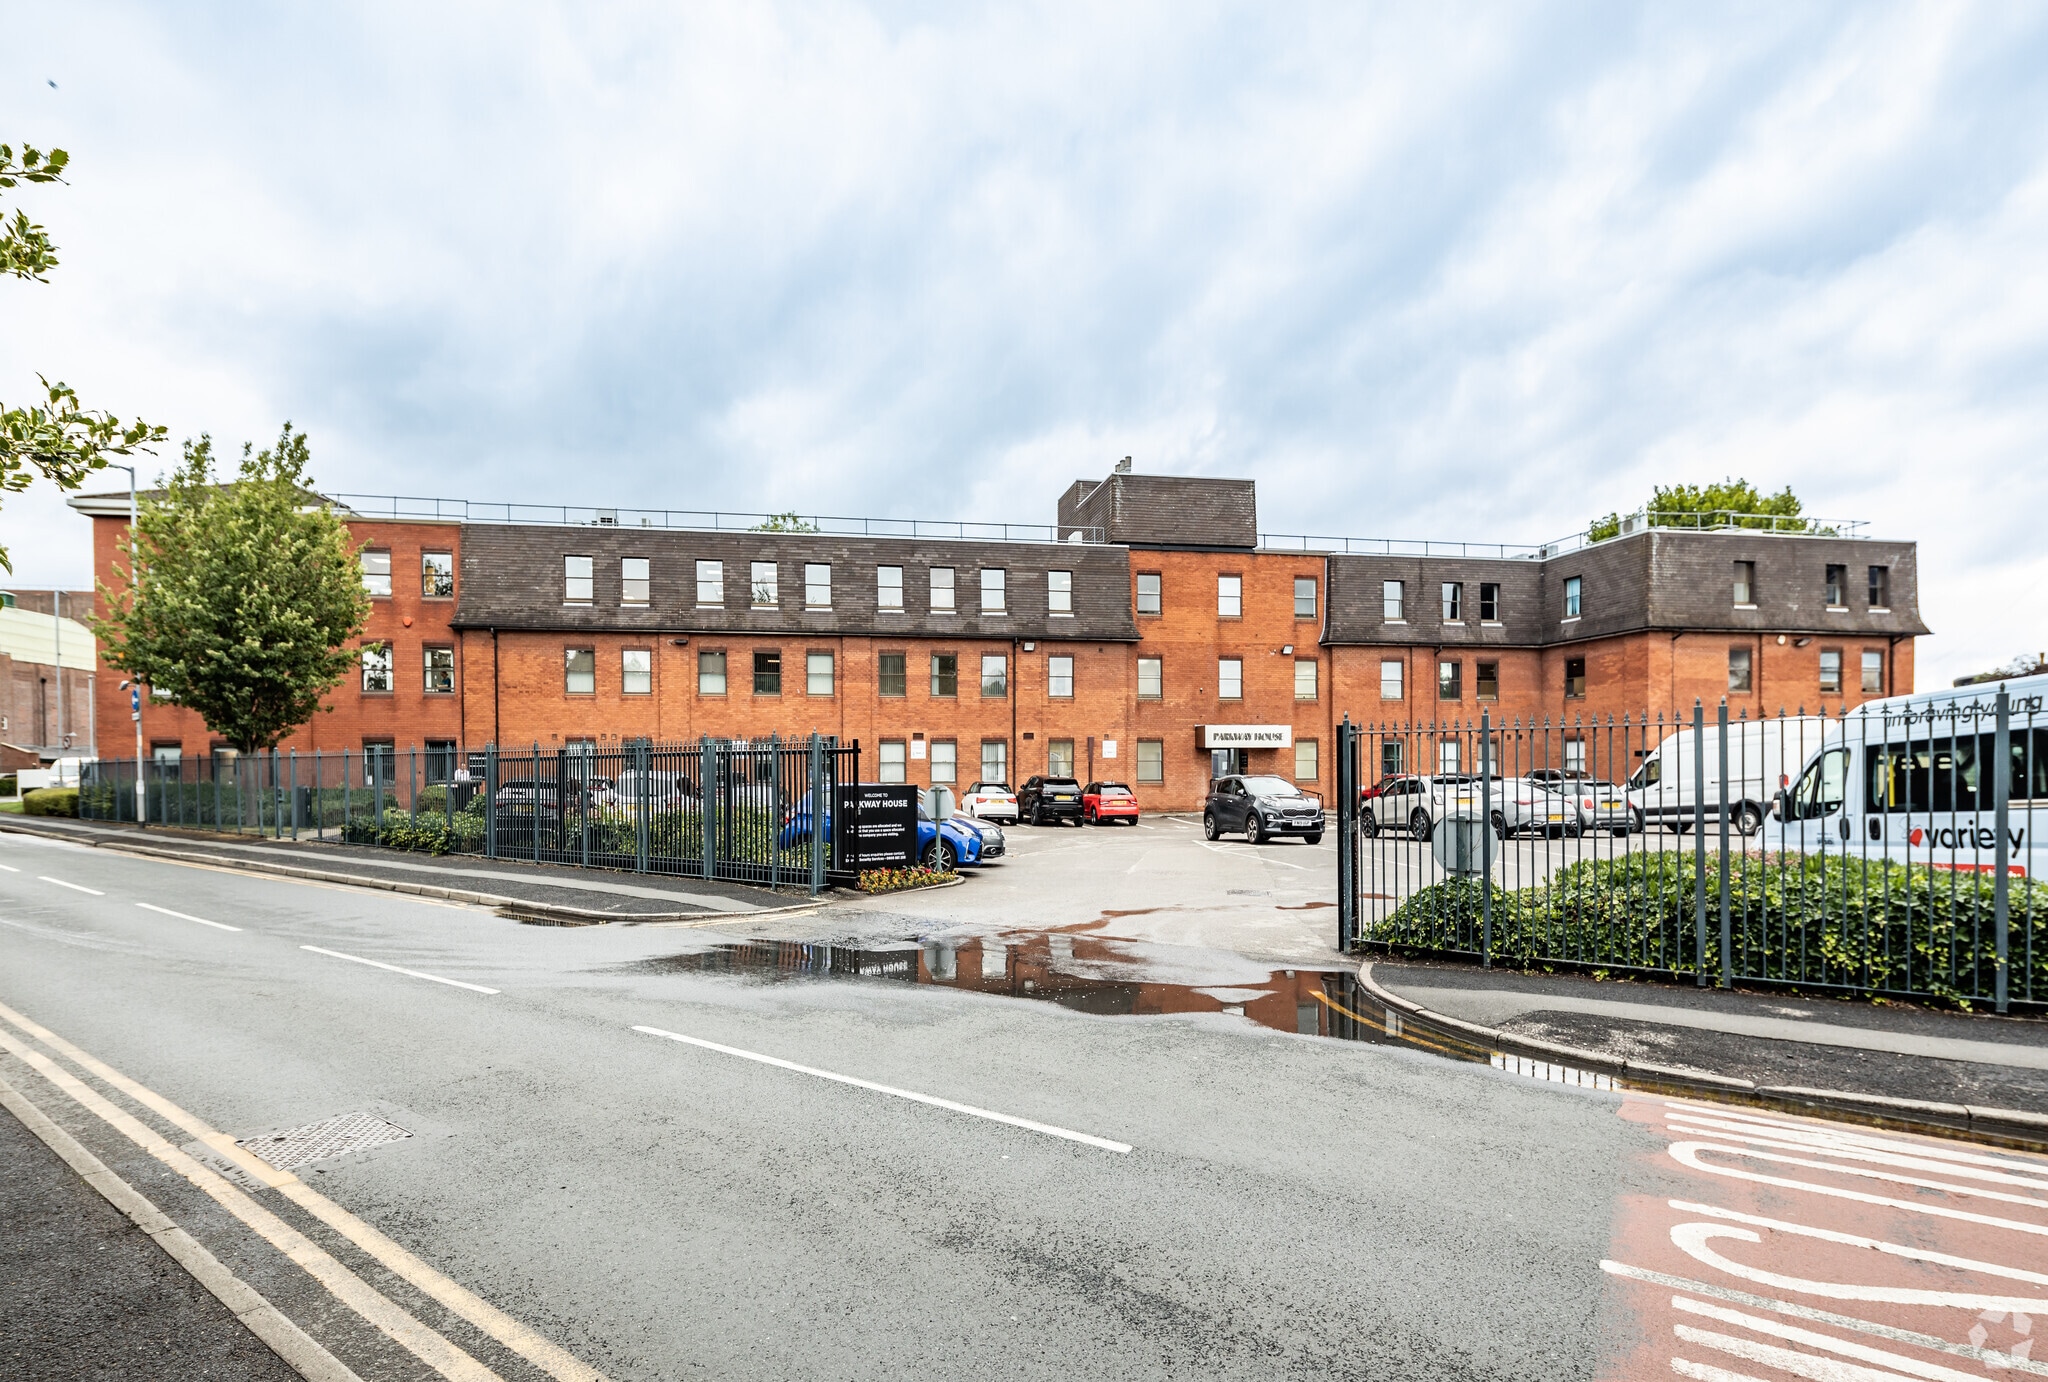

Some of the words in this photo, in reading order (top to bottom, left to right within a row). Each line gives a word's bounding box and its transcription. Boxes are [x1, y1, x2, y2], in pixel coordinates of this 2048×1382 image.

[1213, 732, 1252, 741] PARKWAY
[1254, 732, 1283, 741] HOUSE
[1925, 819, 2024, 859] variey
